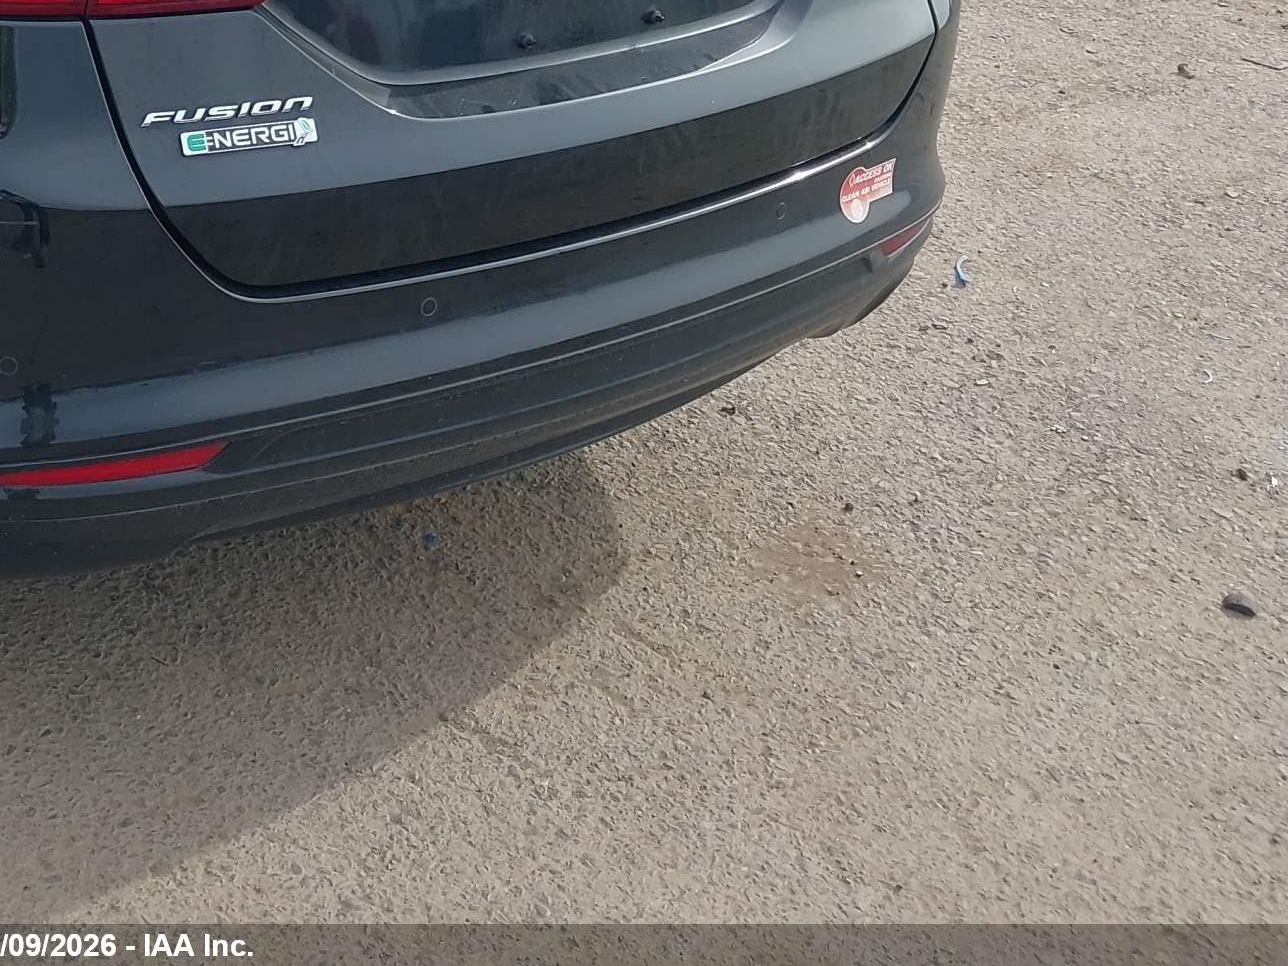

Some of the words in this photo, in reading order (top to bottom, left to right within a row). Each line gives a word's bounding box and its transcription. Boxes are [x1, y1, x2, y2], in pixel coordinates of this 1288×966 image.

[140, 96, 313, 128] FUSION
[187, 123, 295, 152] ENERGI
[855, 166, 883, 184] ACCESS
